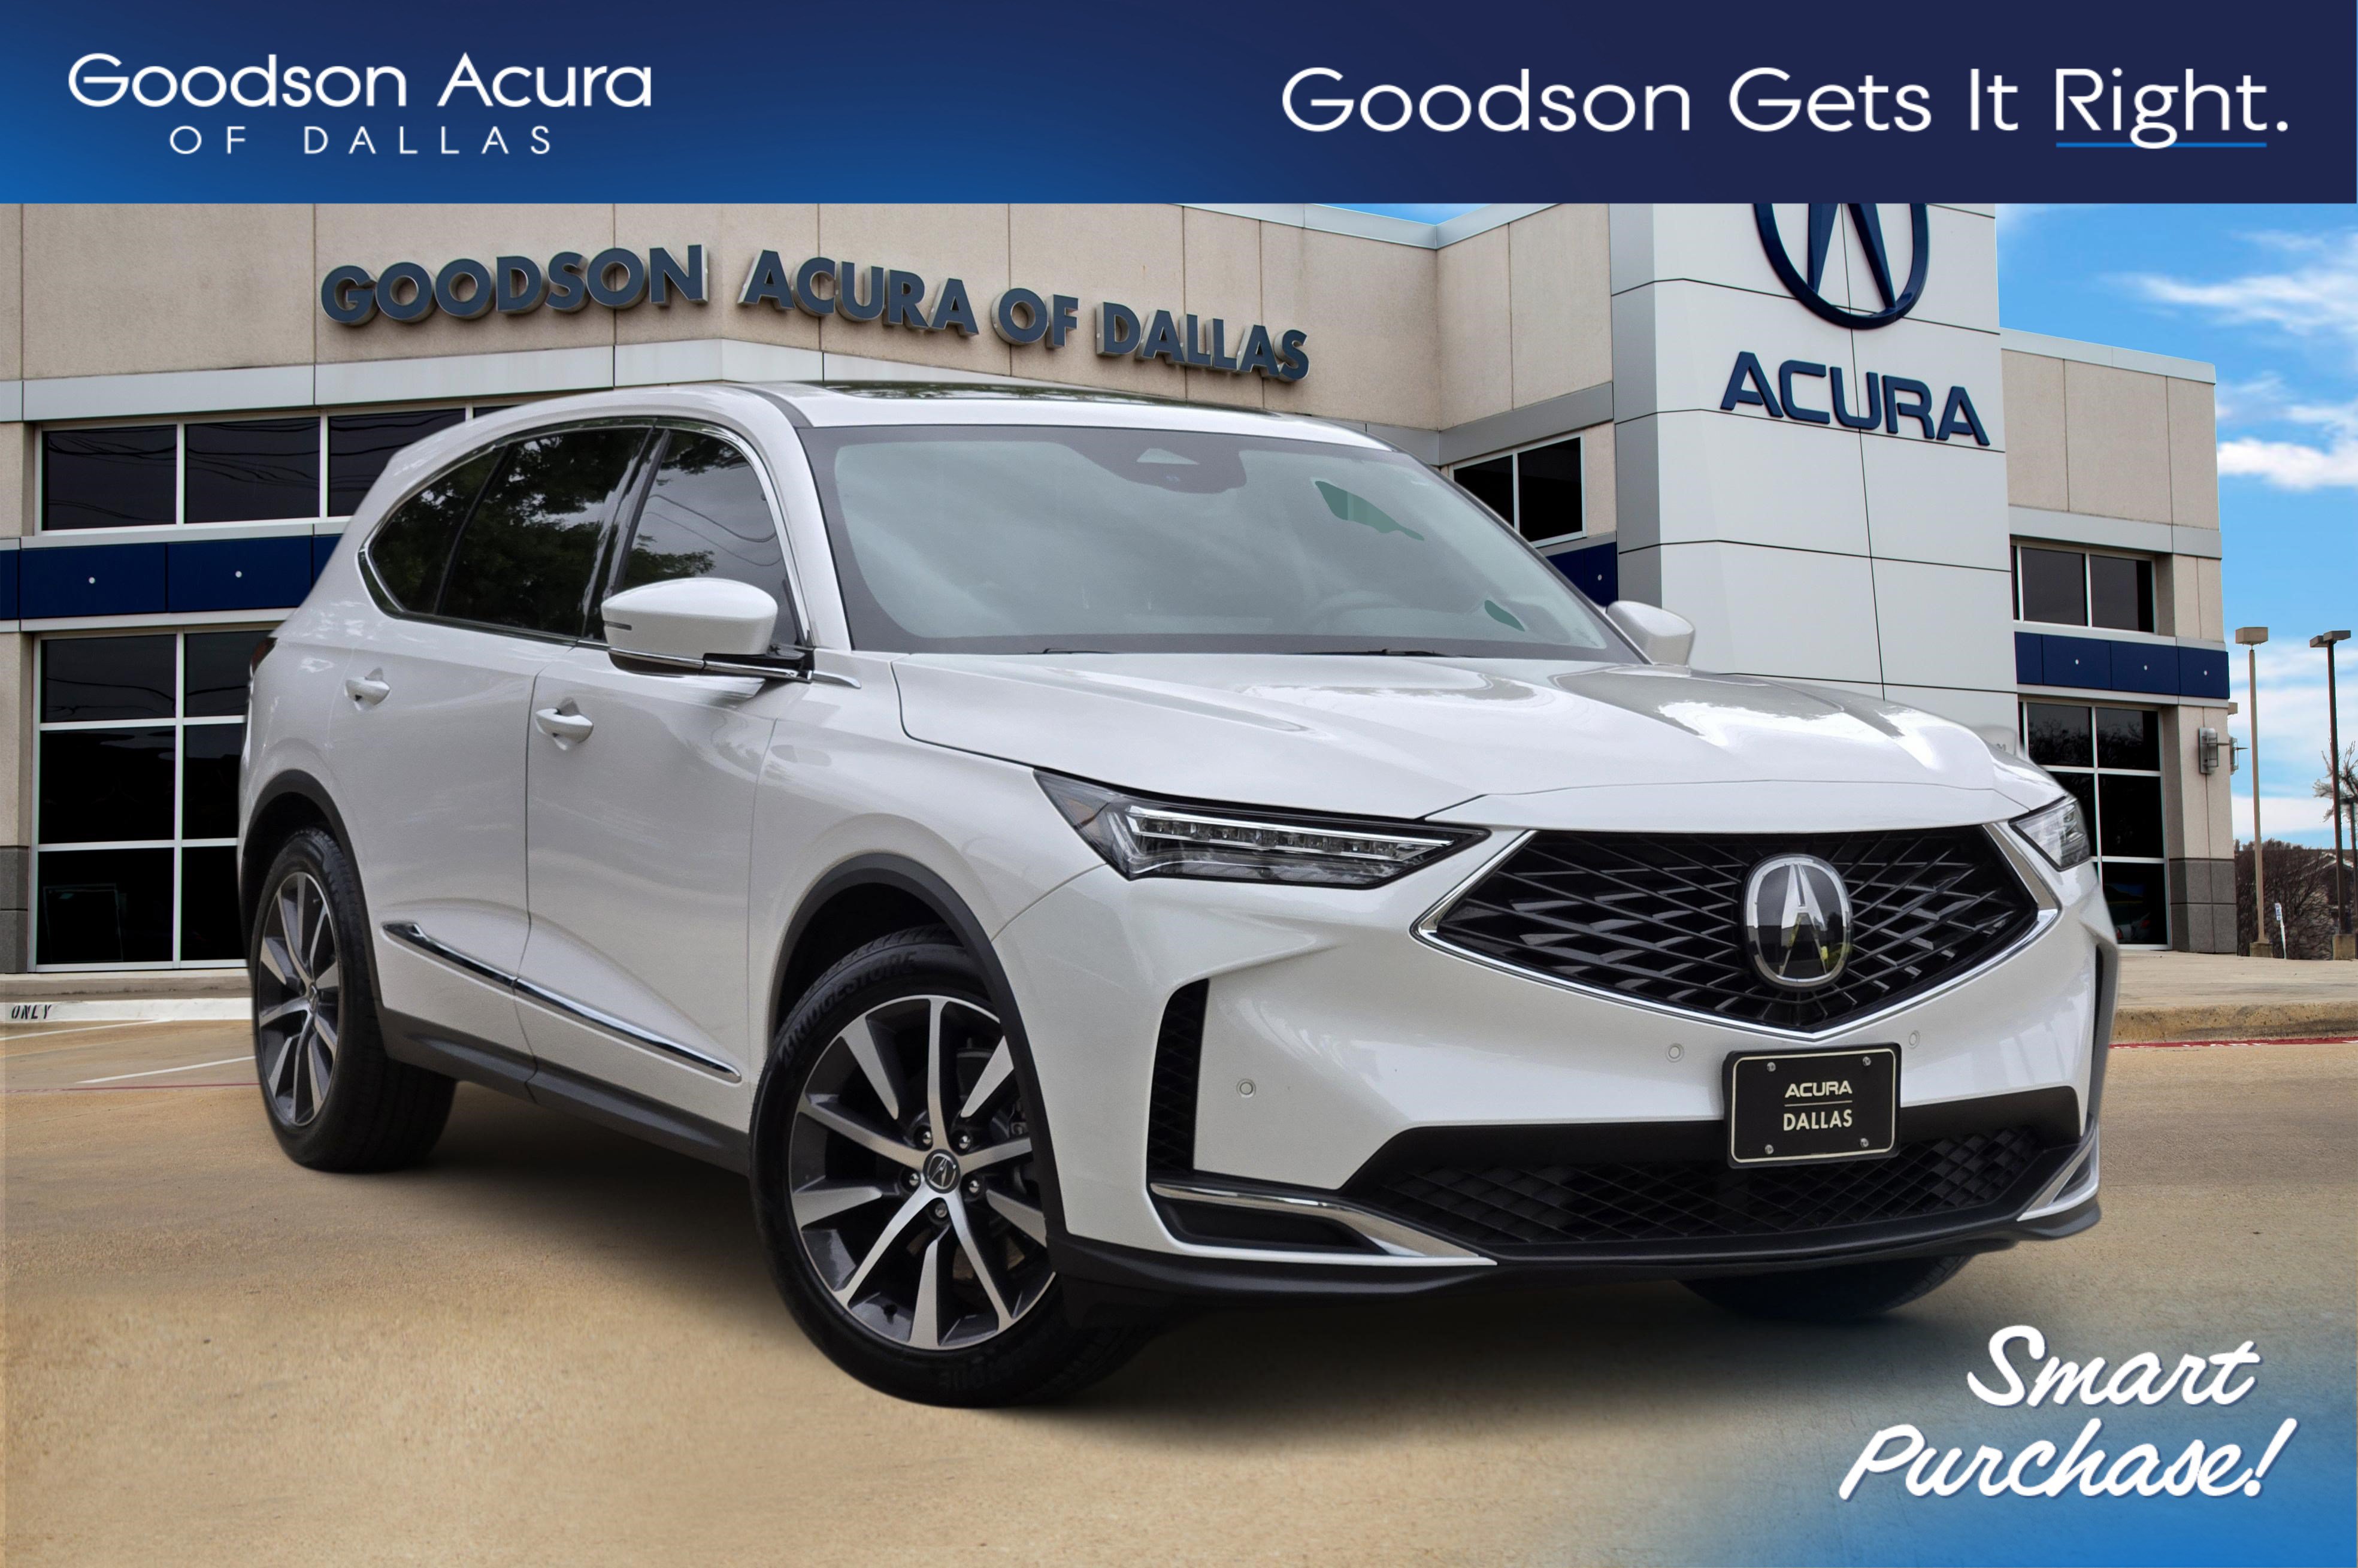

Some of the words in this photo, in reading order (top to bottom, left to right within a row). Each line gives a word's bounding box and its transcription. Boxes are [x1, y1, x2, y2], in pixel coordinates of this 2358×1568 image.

[320, 244, 709, 325] GOODSON
[738, 249, 979, 336] ACURA
[991, 287, 1078, 349] OF
[1095, 301, 1310, 382] DALLAS
[1720, 351, 1991, 446] ACURA
[11, 1004, 53, 1020] ONLY
[1784, 1080, 1853, 1098] ACURA
[1782, 1109, 1853, 1131] DALLAS
